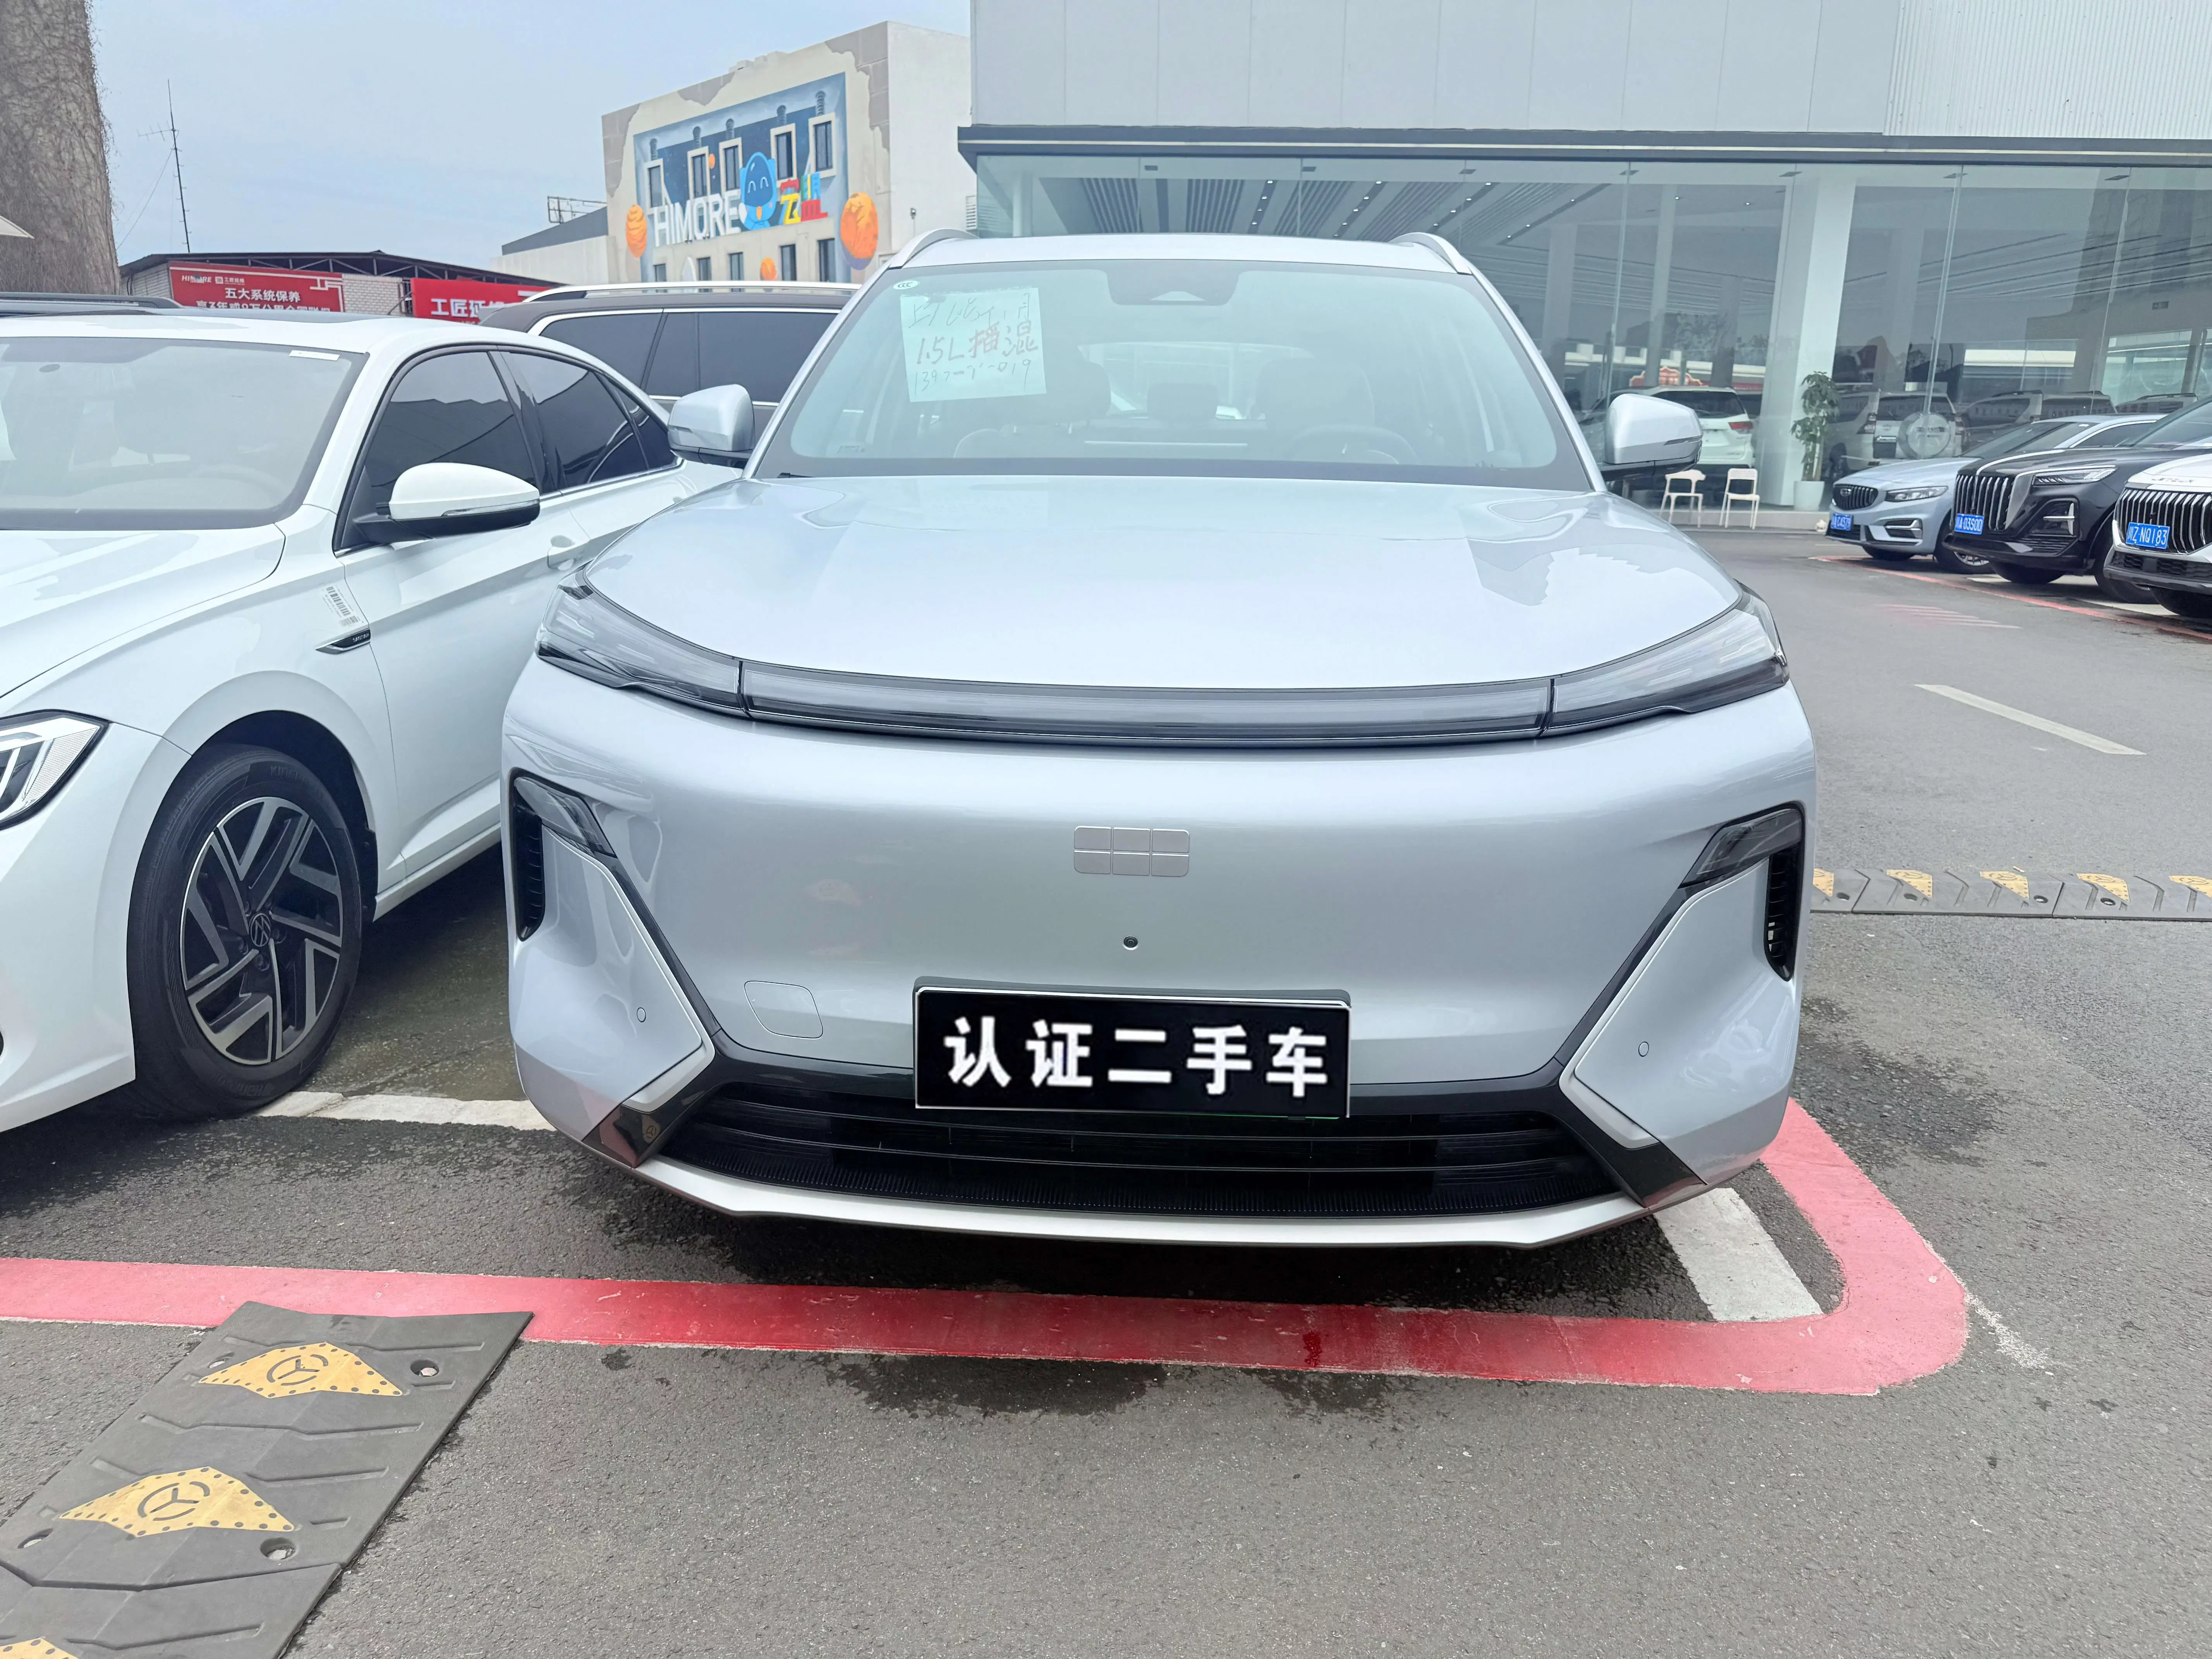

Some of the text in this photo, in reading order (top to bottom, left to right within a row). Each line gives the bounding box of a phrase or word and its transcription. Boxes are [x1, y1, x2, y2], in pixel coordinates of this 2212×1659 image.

[653, 190, 742, 247] HIMORE
[182, 275, 212, 283] HIRE
[225, 288, 301, 303] 五大系统保养
